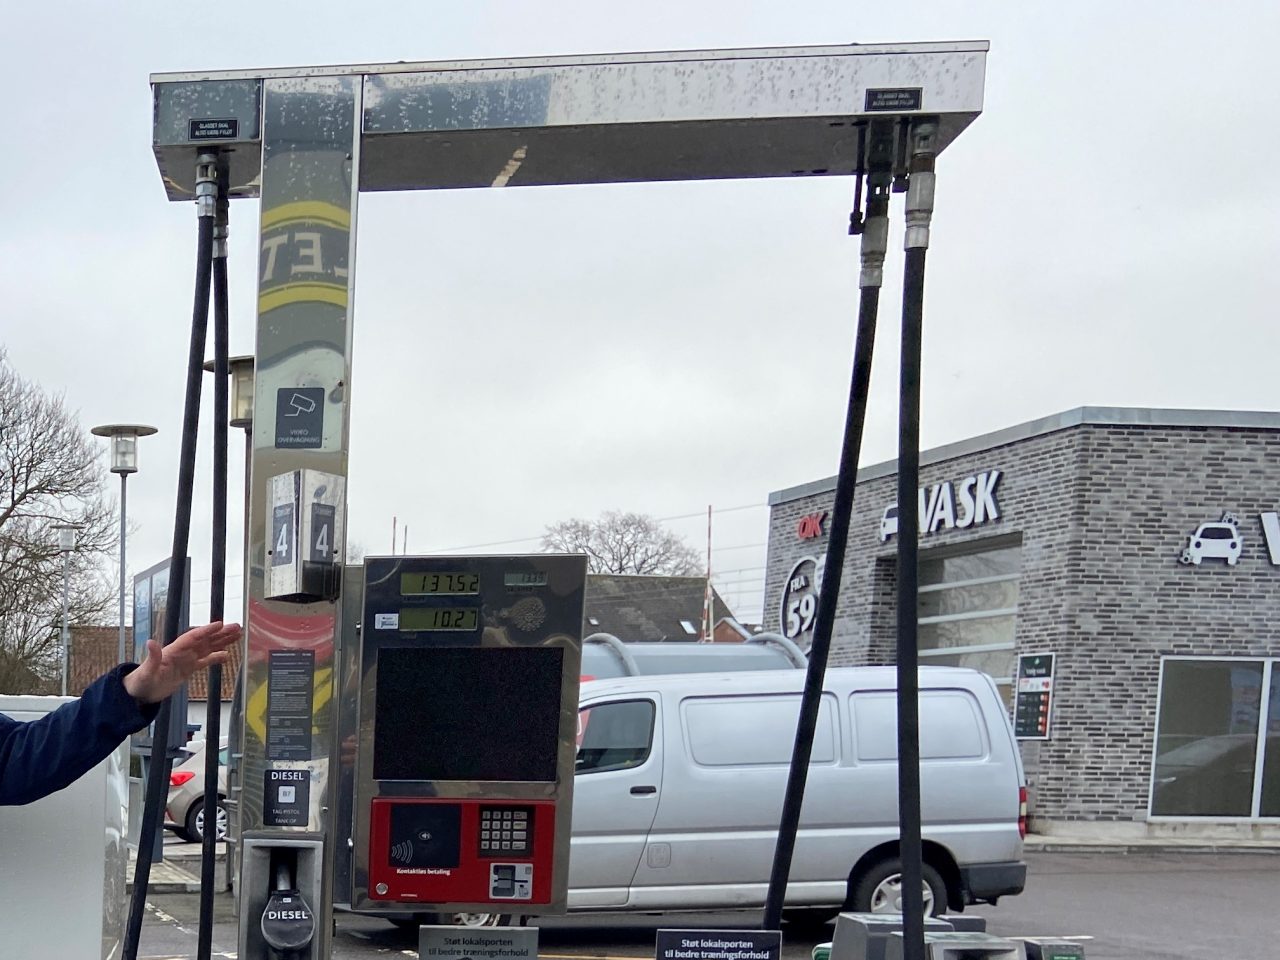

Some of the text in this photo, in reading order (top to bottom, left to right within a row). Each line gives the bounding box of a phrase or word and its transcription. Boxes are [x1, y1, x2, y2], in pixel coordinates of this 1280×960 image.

[918, 470, 1001, 533] VASK
[798, 512, 822, 539] OK
[276, 523, 288, 557] 4
[315, 523, 329, 557] 4
[421, 575, 479, 592] 137.52
[790, 576, 806, 592] FRA
[433, 610, 478, 628] 10.27
[787, 593, 816, 638] 59
[271, 772, 304, 781] DIESEL
[427, 868, 451, 876] betaling
[268, 911, 308, 920] DIESEL
[443, 937, 513, 947] Støt lokalsporten
[681, 939, 753, 950] Støt lokalsporten
[438, 948, 461, 956] bedre
[463, 948, 529, 958] træningsforhold
[665, 950, 770, 960] til bedre træningsforhold
